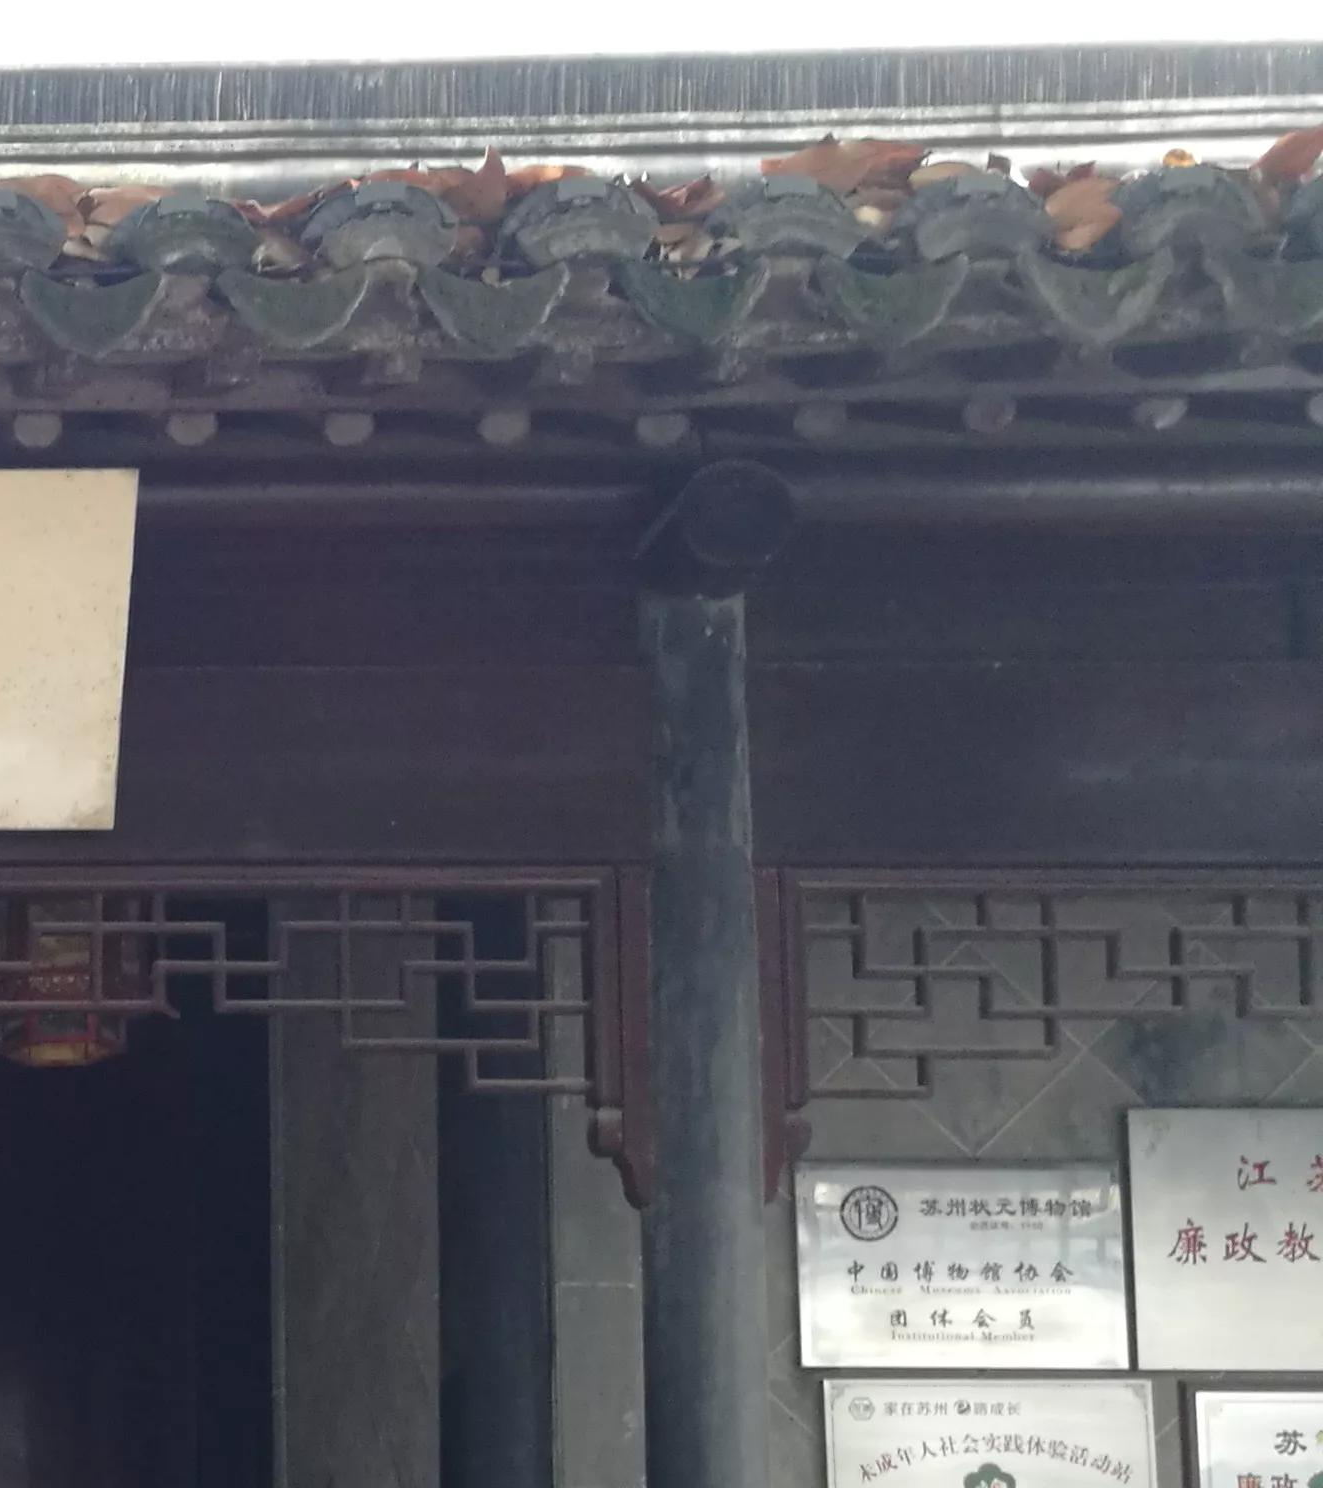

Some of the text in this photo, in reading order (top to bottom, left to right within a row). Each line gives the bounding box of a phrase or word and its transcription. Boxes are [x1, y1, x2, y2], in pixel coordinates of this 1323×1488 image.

[919, 1198, 1092, 1217] 苏州状元博物馆
[847, 1260, 1074, 1283] 中国博物馆协会
[890, 1309, 1035, 1330] 团体会员
[858, 1433, 1134, 1486] 未成年人社会实践体验活动站
